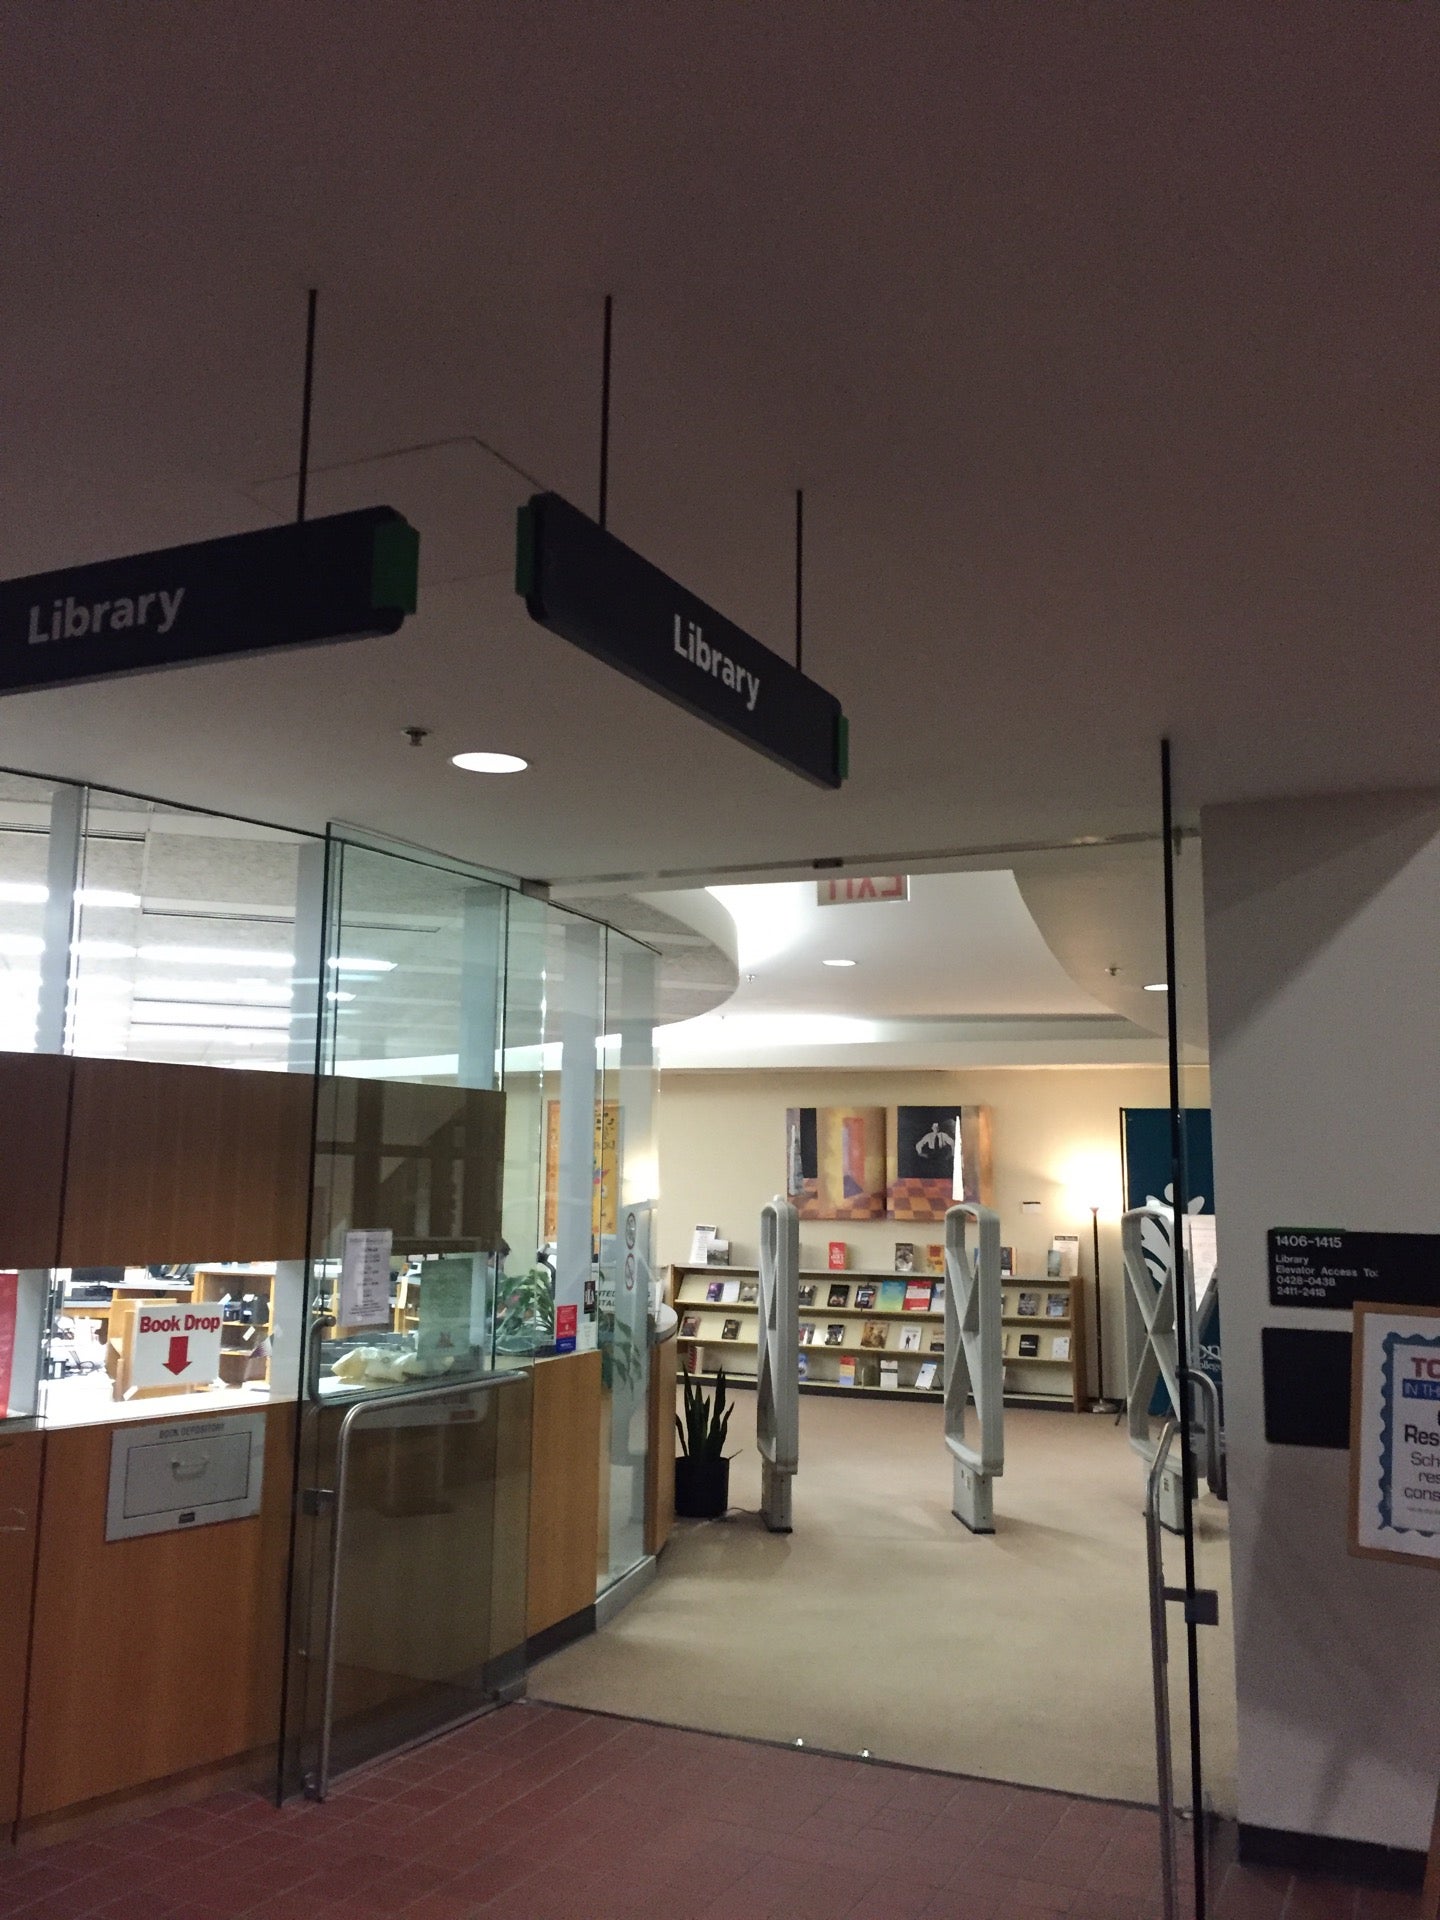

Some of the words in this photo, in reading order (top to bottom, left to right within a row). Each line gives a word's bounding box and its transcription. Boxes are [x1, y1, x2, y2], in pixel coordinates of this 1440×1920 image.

[28, 587, 186, 644] Library
[673, 613, 760, 711] Library
[1275, 1235, 1343, 1249] 1406-1415
[1275, 1254, 1309, 1266] Library
[1275, 1265, 1316, 1275] Elevator
[140, 1315, 180, 1334] Book
[184, 1314, 221, 1333] Drop
